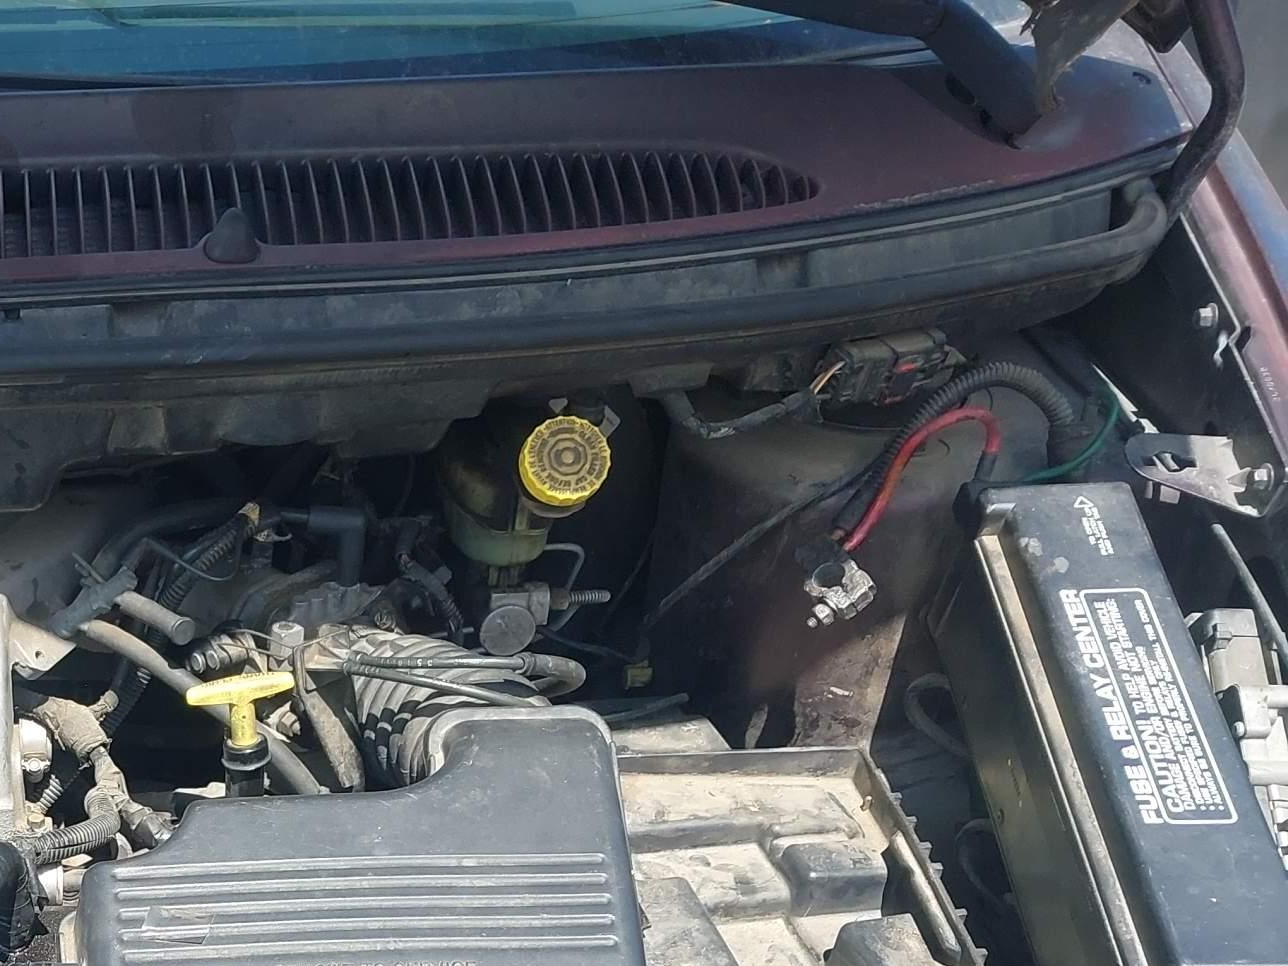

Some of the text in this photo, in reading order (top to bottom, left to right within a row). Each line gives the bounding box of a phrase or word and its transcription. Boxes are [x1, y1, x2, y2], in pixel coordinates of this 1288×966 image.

[1124, 650, 1143, 672] NOT
[1059, 589, 1164, 824] FUSE & RELAY CENTER
[1093, 601, 1185, 813] CAUTION! TO HELP AVOID VEHICLE
[1134, 674, 1159, 714] ENGINE
[1150, 716, 1177, 760] AND/OR
[1183, 722, 1195, 734] TO
[1167, 762, 1197, 811] DAMAGE
